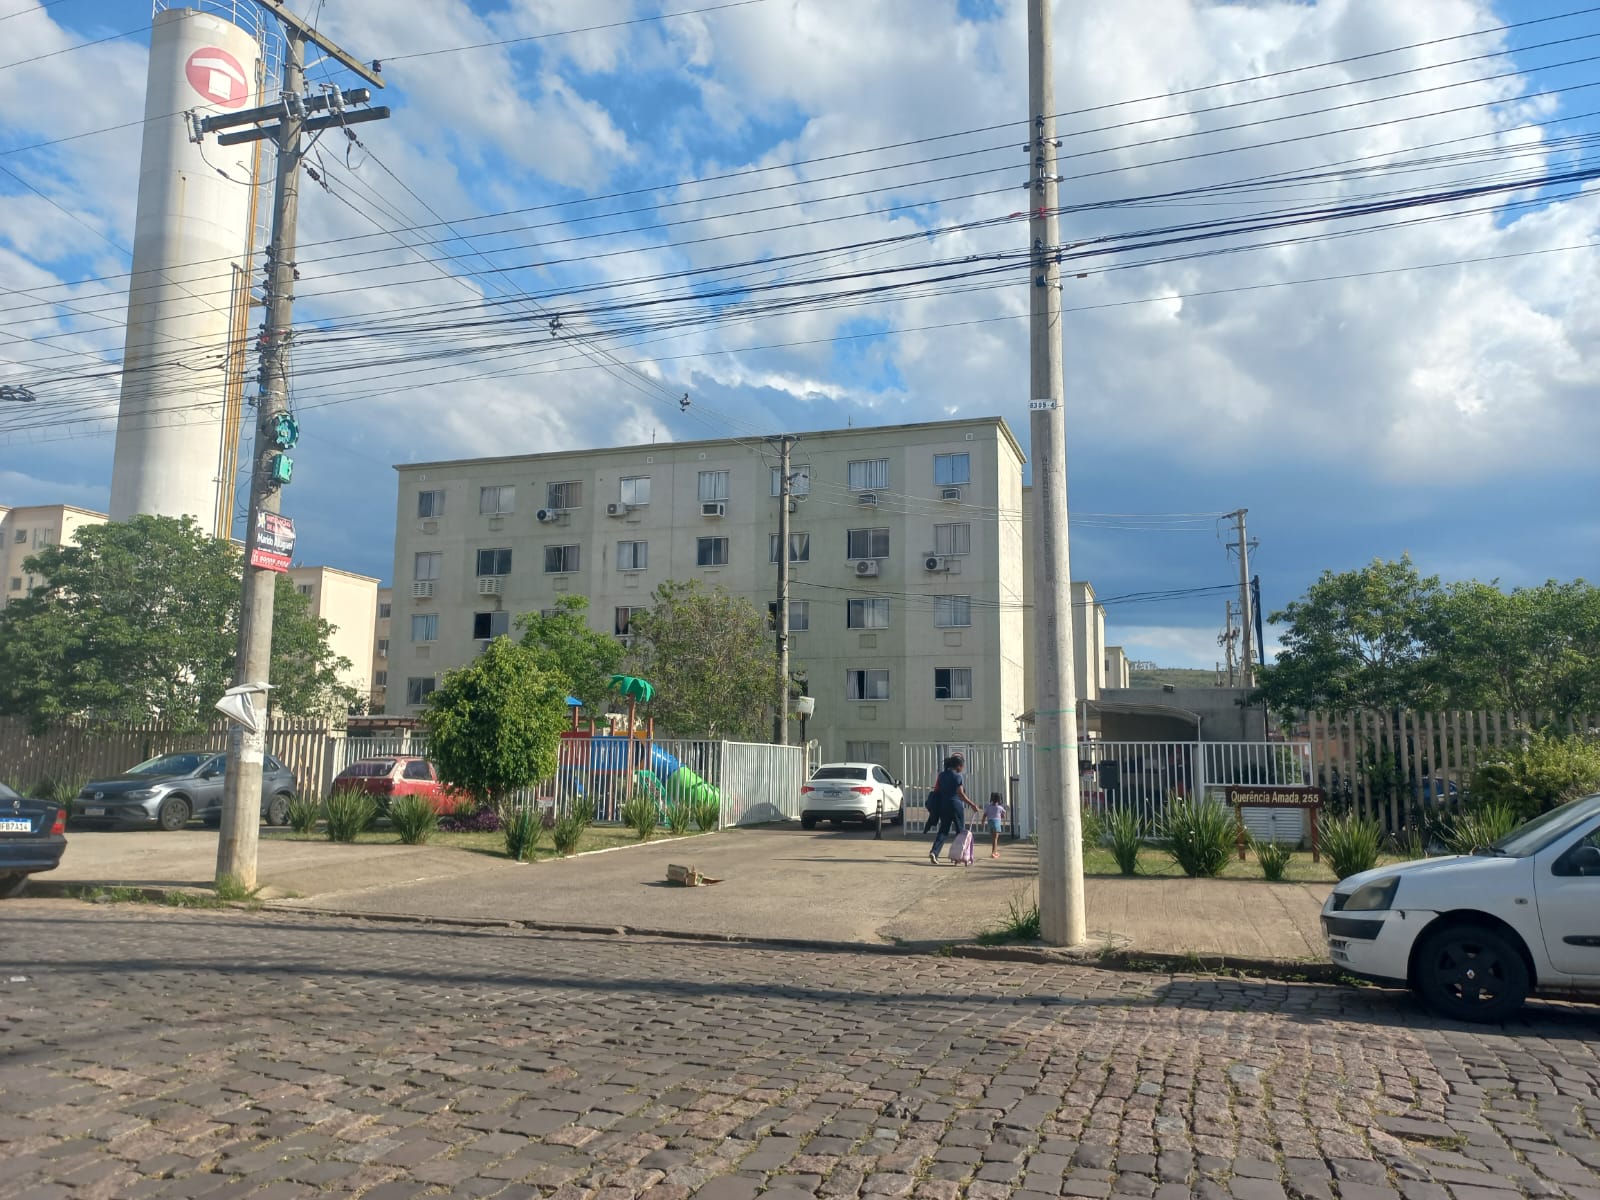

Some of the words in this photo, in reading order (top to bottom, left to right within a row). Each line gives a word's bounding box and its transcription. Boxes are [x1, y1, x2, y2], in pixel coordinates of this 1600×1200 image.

[1231, 790, 1270, 803] Querência
[1271, 791, 1301, 805] Amada,
[1302, 794, 1319, 803] 255
[0, 822, 28, 831] FB7A14
